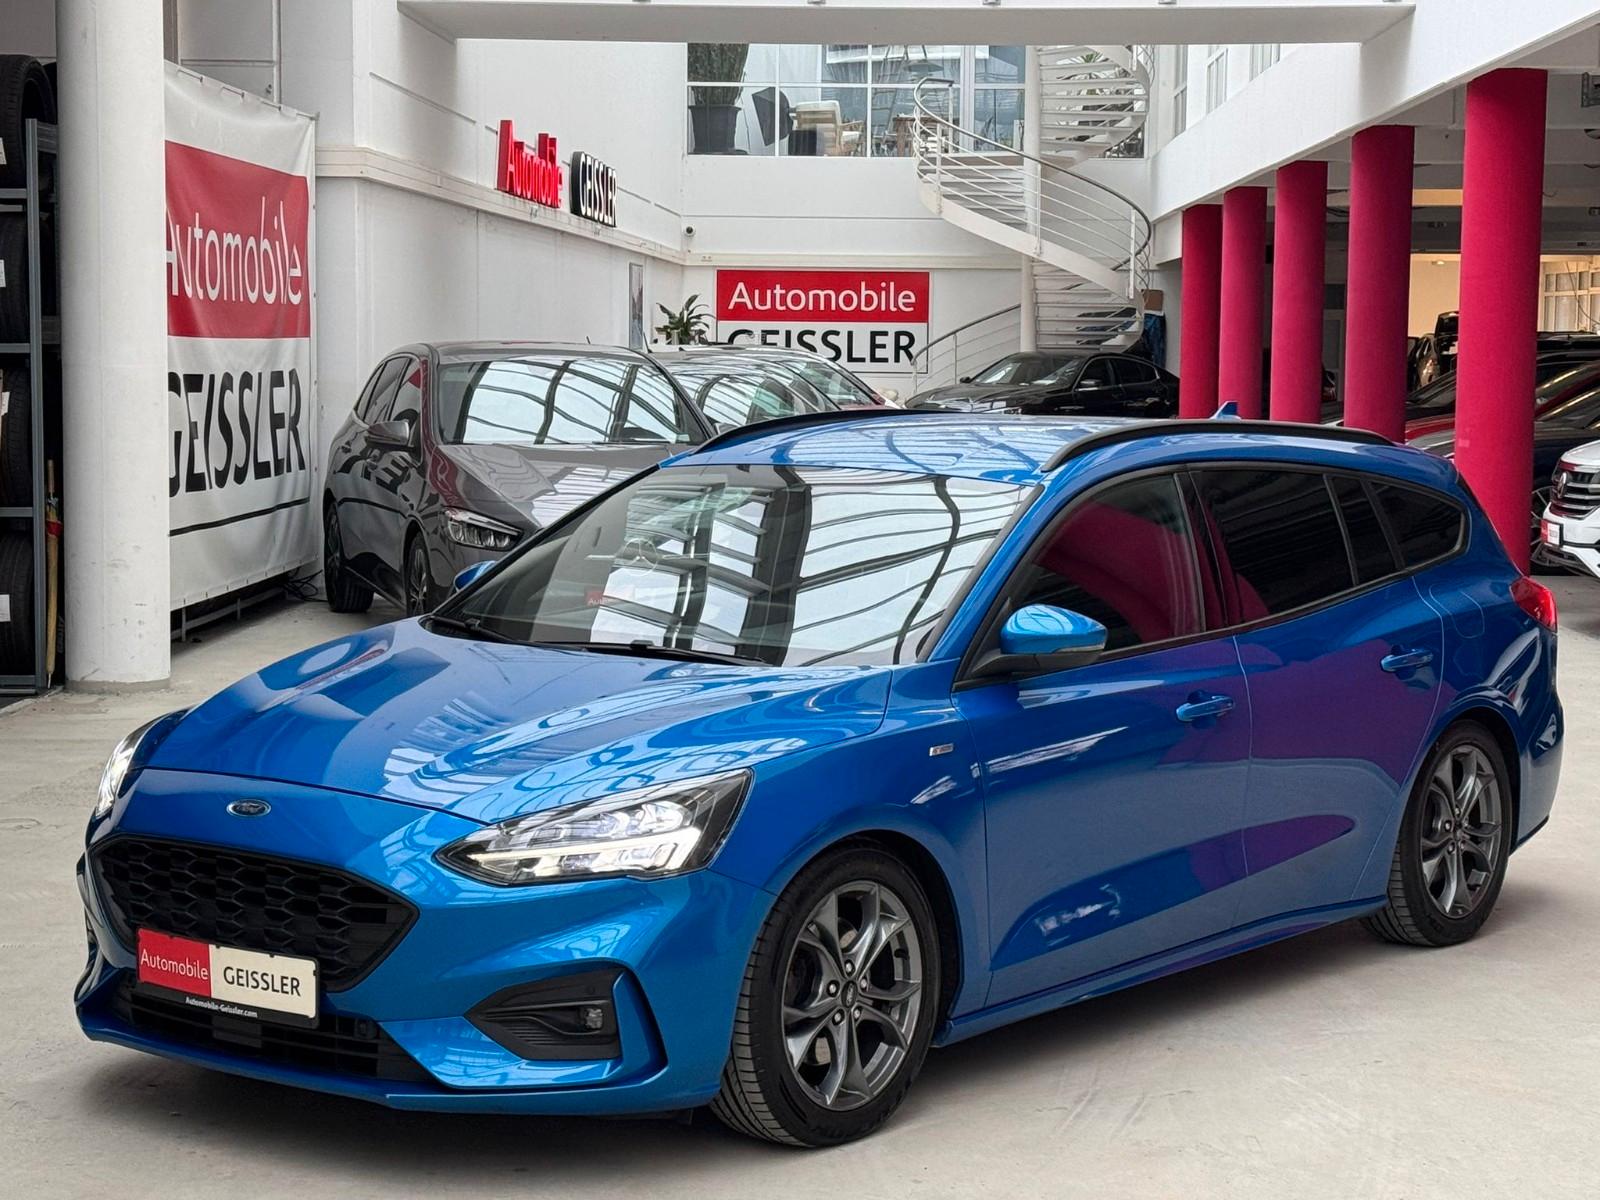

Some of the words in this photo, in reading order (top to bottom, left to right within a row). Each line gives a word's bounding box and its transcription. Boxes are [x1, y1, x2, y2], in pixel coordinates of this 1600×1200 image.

[578, 151, 617, 227] GEISSLER
[728, 281, 916, 312] Automobile
[140, 949, 209, 980] Automobile
[223, 966, 301, 997] GEISSLER
